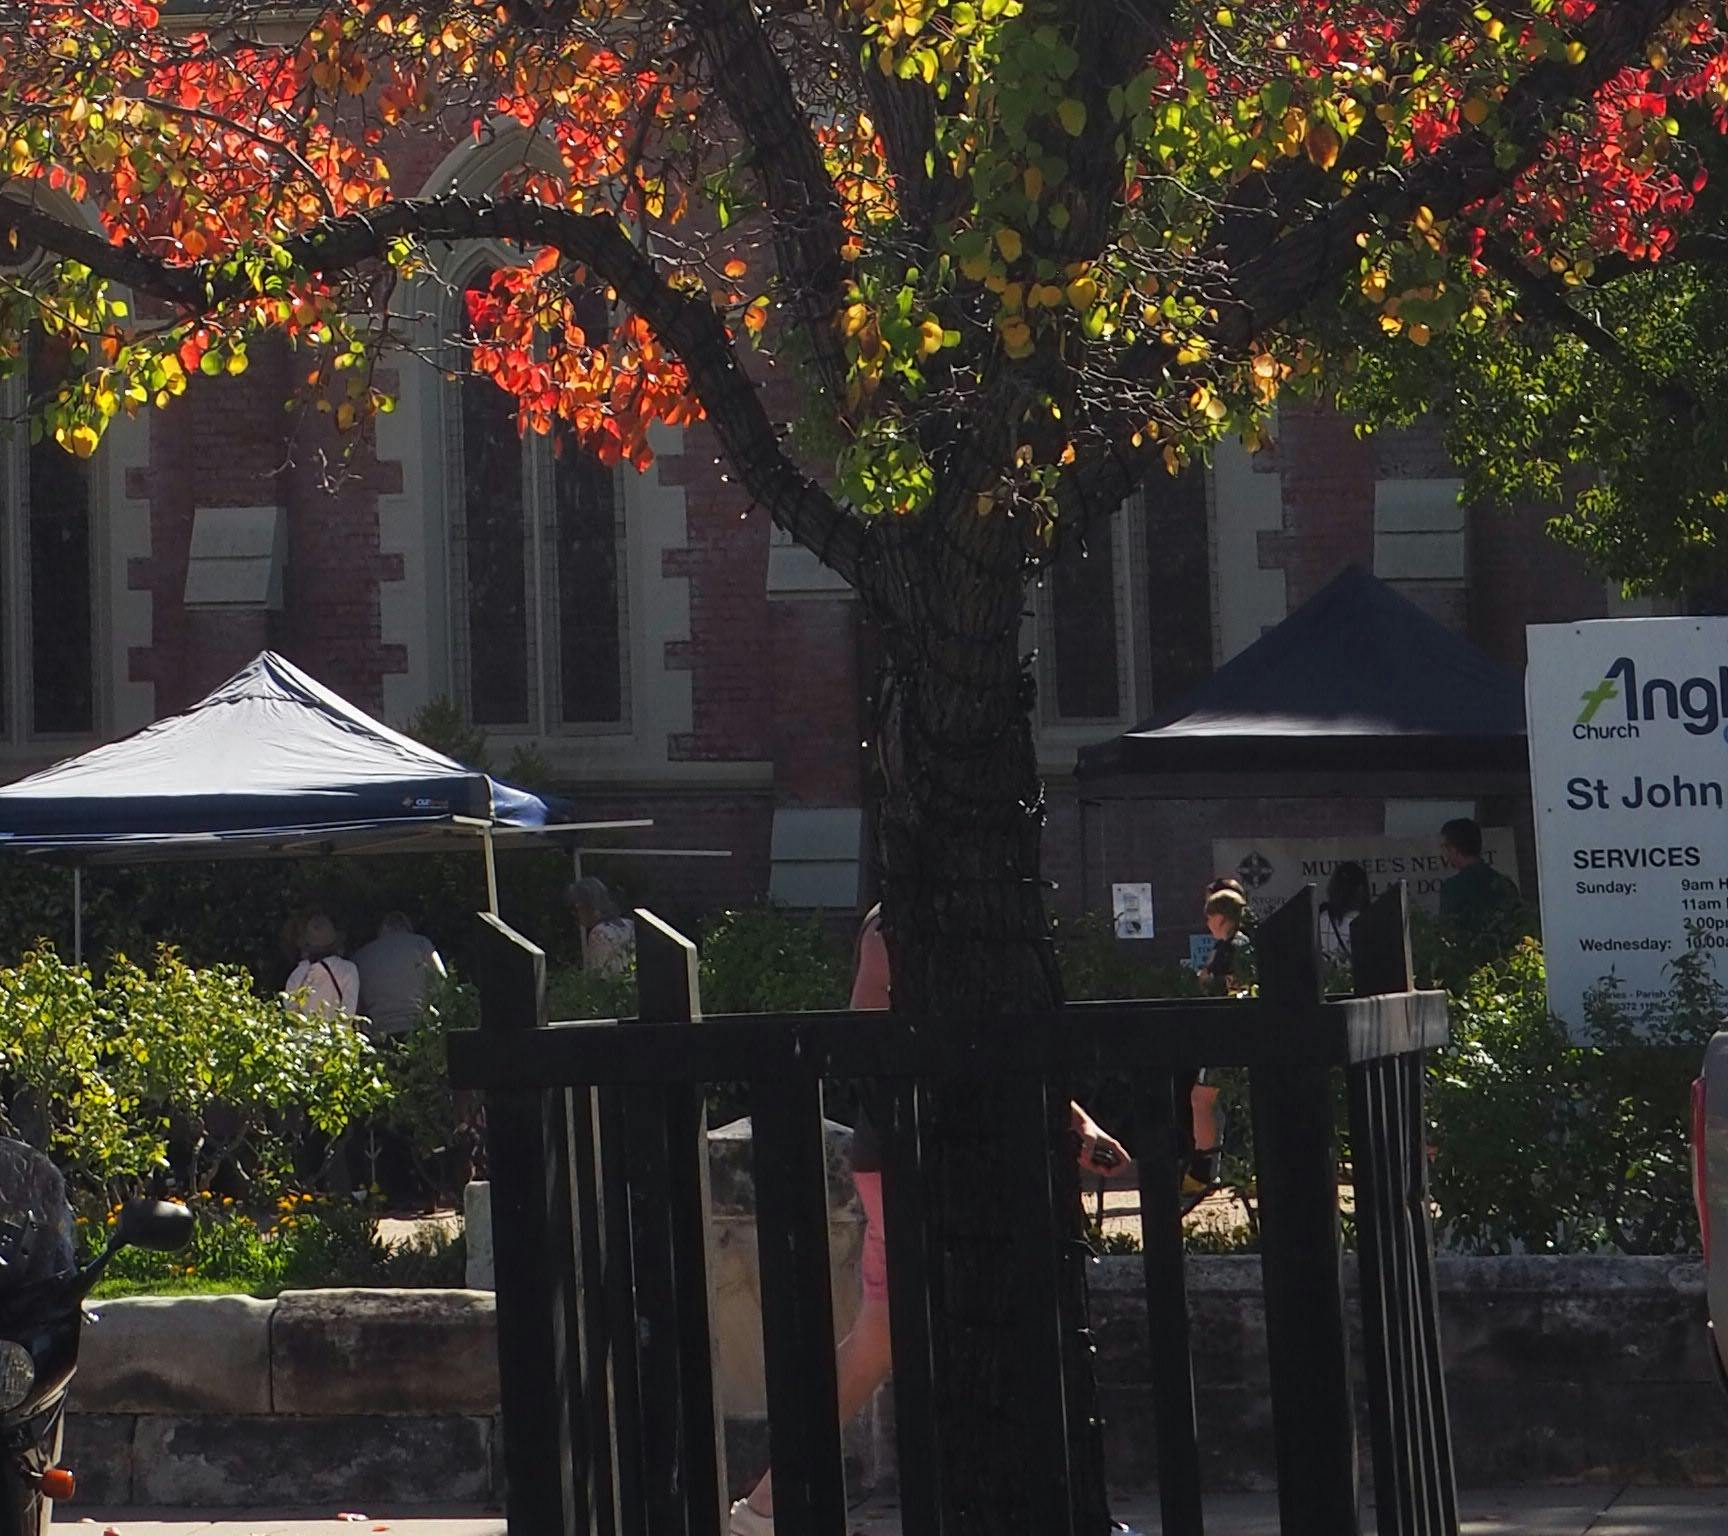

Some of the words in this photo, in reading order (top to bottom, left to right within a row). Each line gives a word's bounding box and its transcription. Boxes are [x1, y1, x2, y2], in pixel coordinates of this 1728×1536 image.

[1572, 723, 1640, 739] Church
[1566, 777, 1610, 810] St
[1622, 775, 1723, 809] John
[1573, 846, 1701, 869] SERVICES
[1576, 880, 1638, 895] Sunday:
[1681, 878, 1714, 891] 9am
[1681, 897, 1721, 910] 11am
[1579, 937, 1672, 952] Wednesday:
